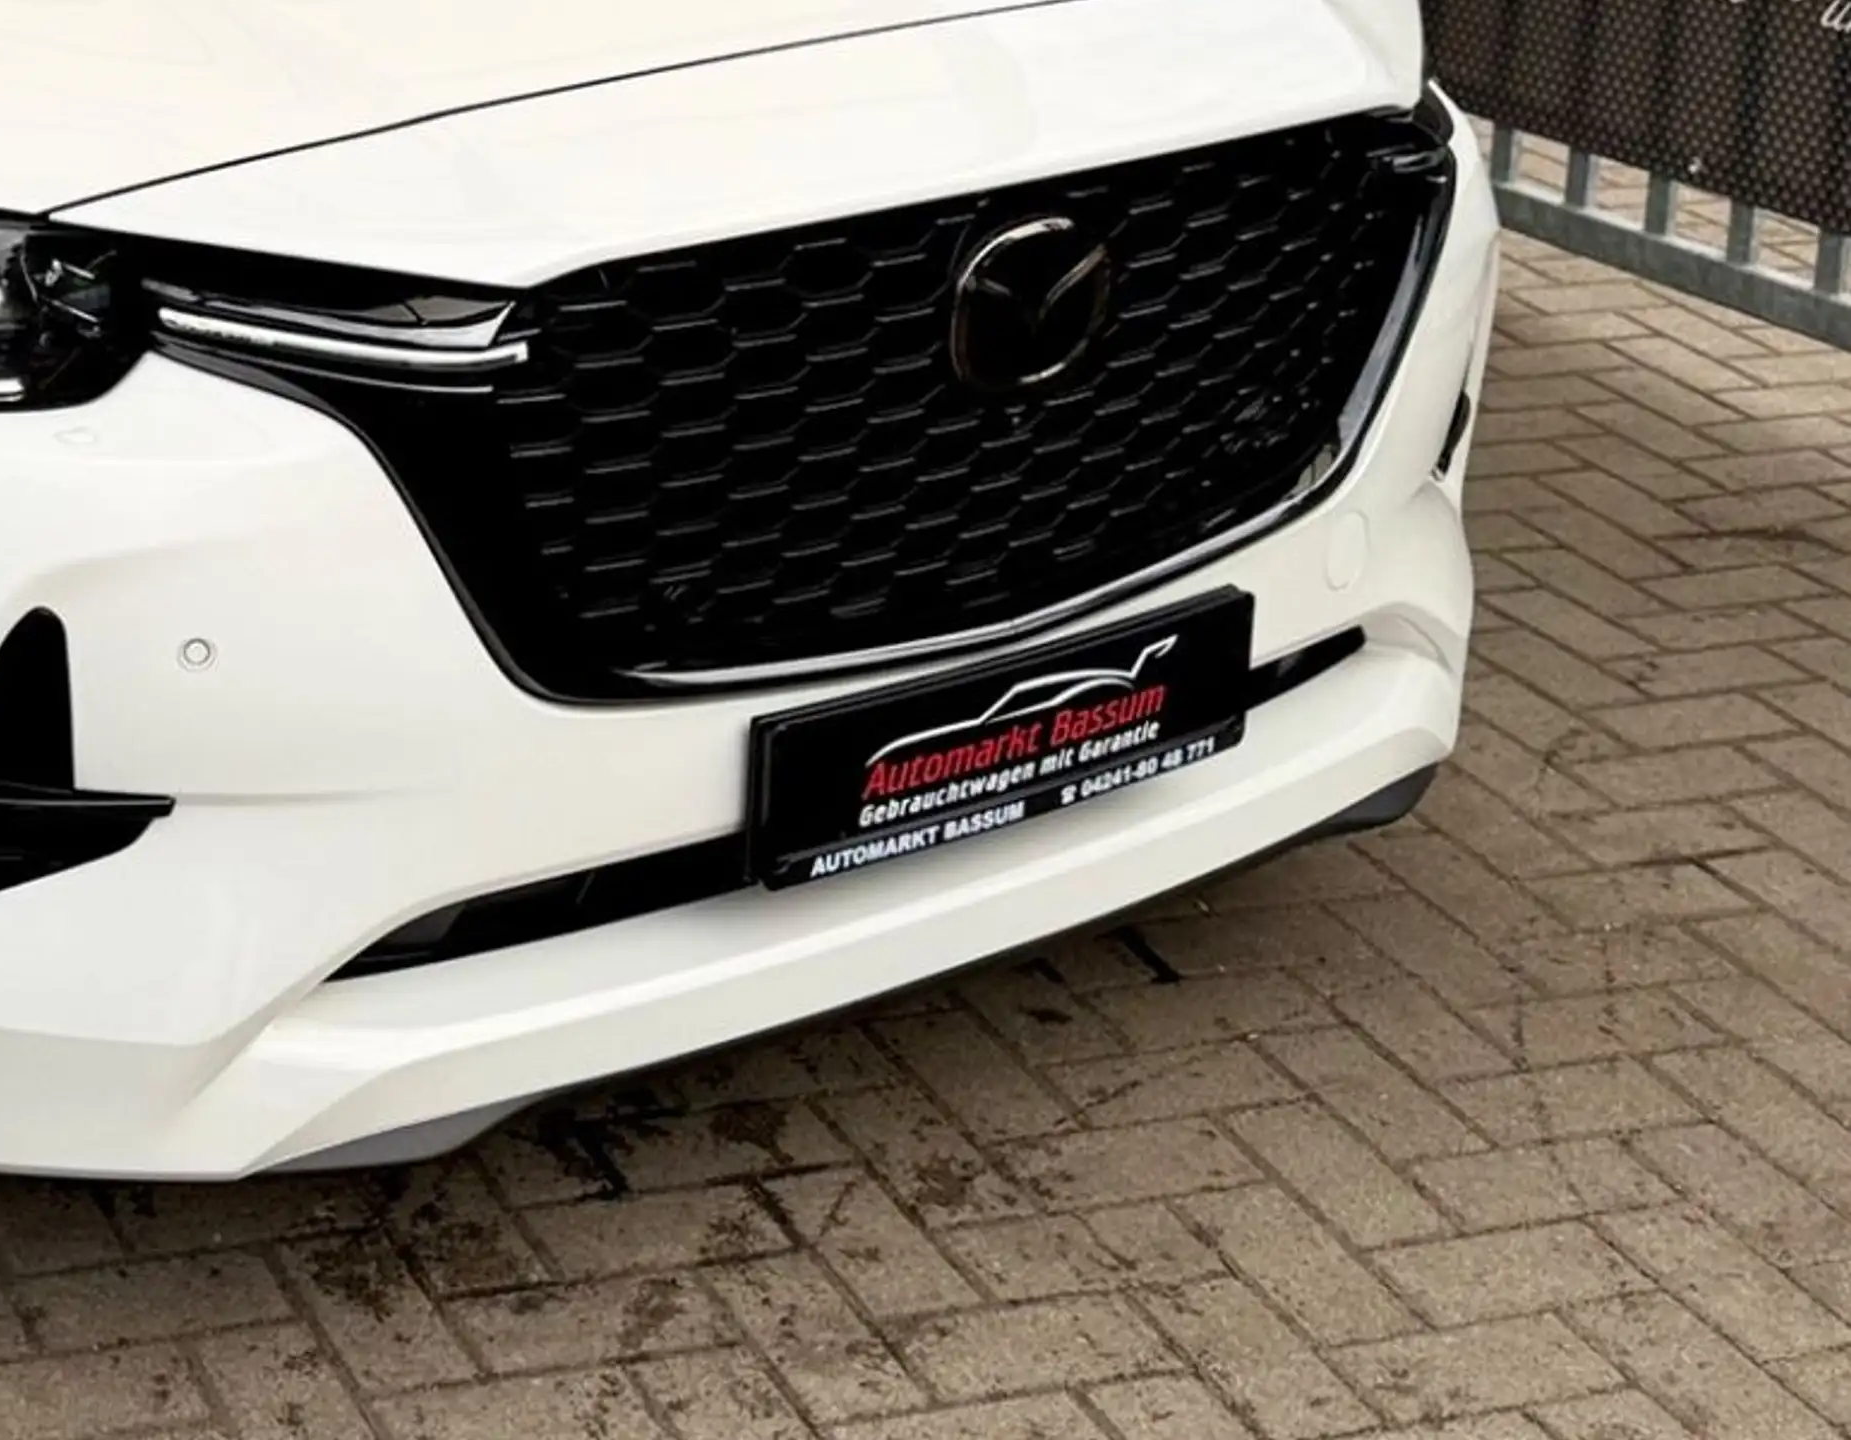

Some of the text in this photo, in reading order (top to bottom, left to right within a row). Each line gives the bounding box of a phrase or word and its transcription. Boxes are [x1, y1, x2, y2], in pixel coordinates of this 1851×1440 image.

[859, 720, 1161, 827] Gebrauchtwagen mit Garantie
[861, 685, 1167, 800] Automarkt Bassum
[810, 825, 940, 877] AUTOMARKT
[943, 801, 1026, 840] BASSUM
[1187, 736, 1215, 762] 771
